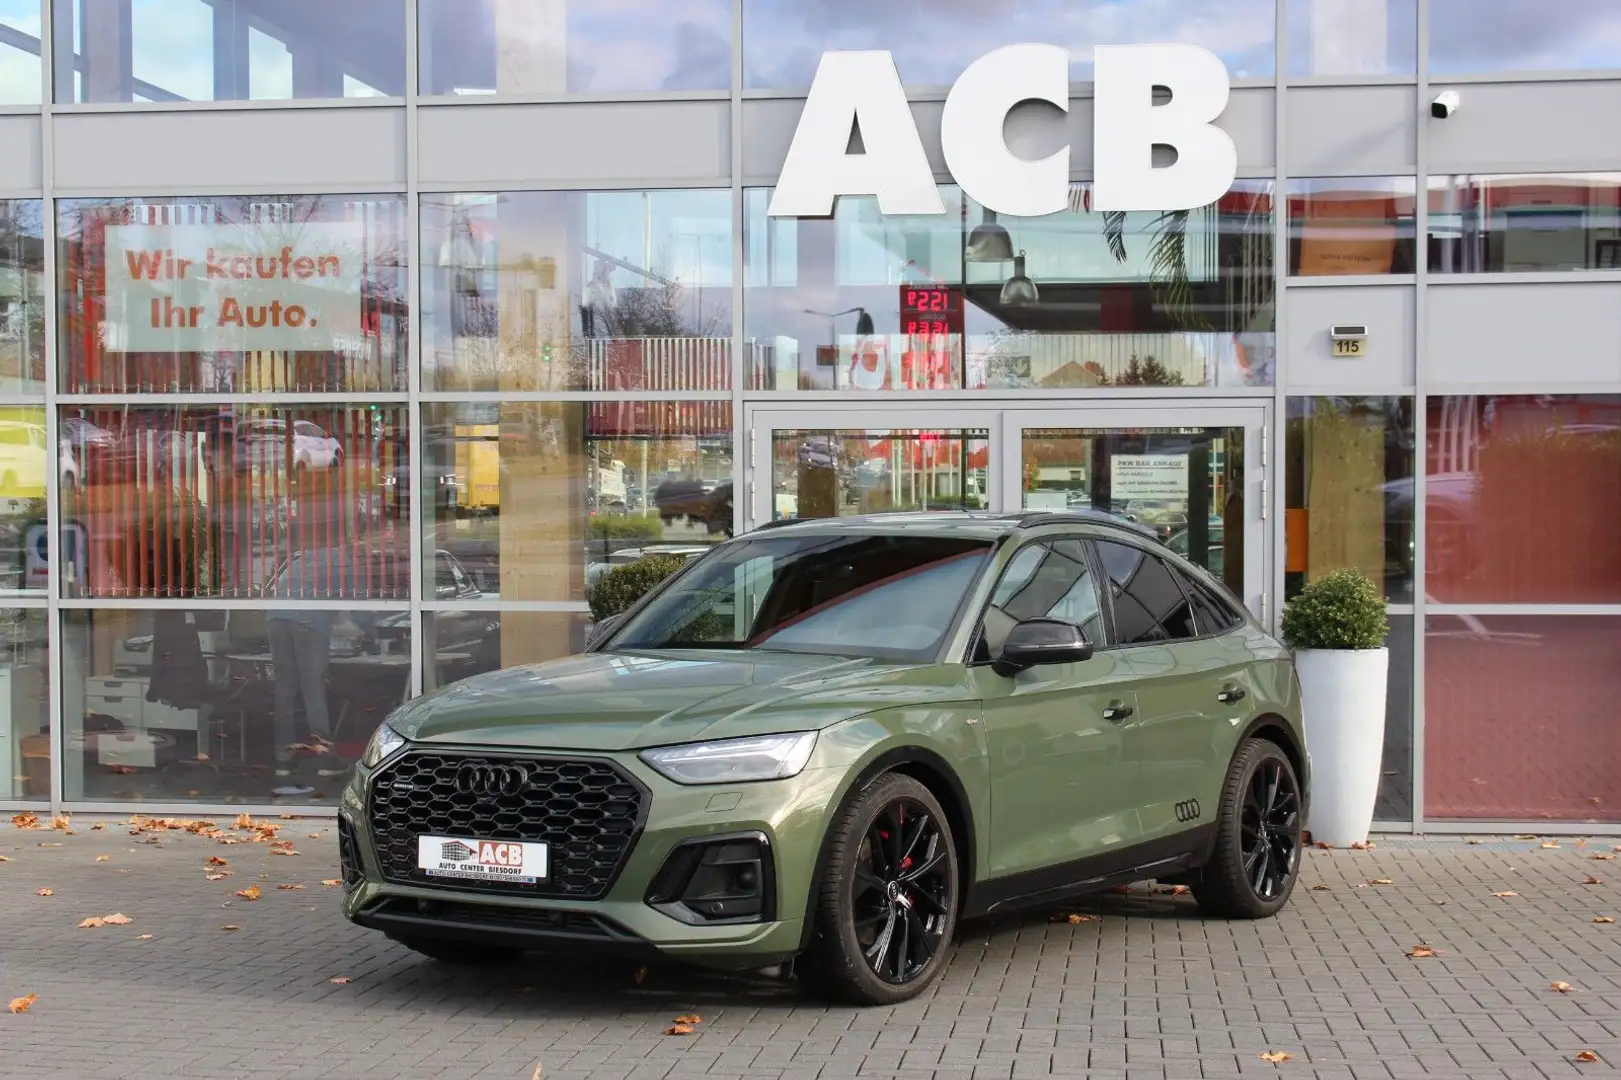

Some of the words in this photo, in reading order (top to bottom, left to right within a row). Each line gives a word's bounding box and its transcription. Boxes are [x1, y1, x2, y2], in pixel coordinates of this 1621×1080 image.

[767, 43, 1237, 217] ACB
[125, 249, 193, 280] Wir
[207, 246, 340, 280] kaufen
[151, 297, 204, 328] Ihr
[217, 297, 318, 328] Auto.
[1337, 340, 1359, 352] 115
[480, 843, 522, 865] ACB
[439, 862, 456, 870] AUTO
[460, 864, 485, 872] CENTER
[489, 866, 522, 875] BIESDORF
